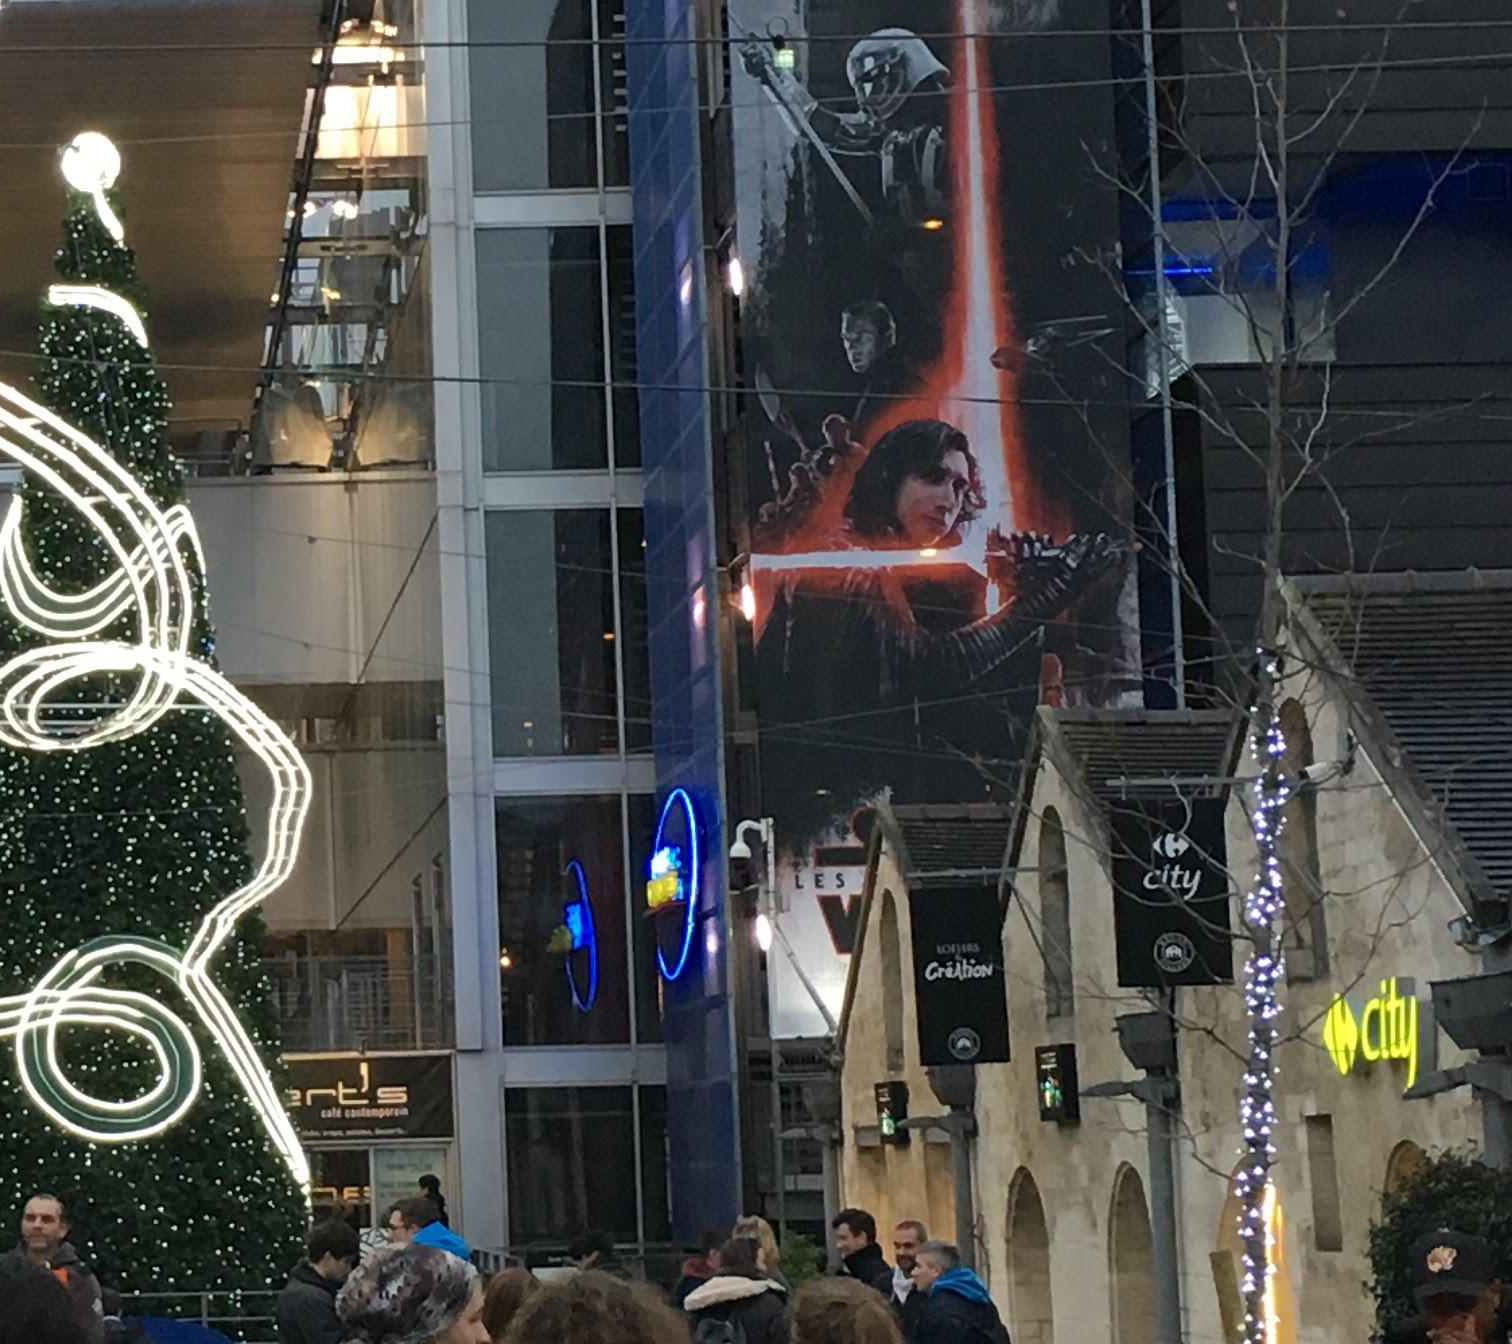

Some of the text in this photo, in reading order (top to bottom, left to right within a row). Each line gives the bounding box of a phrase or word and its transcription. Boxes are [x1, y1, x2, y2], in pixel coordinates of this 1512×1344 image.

[794, 873, 846, 889] LES
[1142, 863, 1202, 901] city
[1361, 976, 1417, 1093] city
